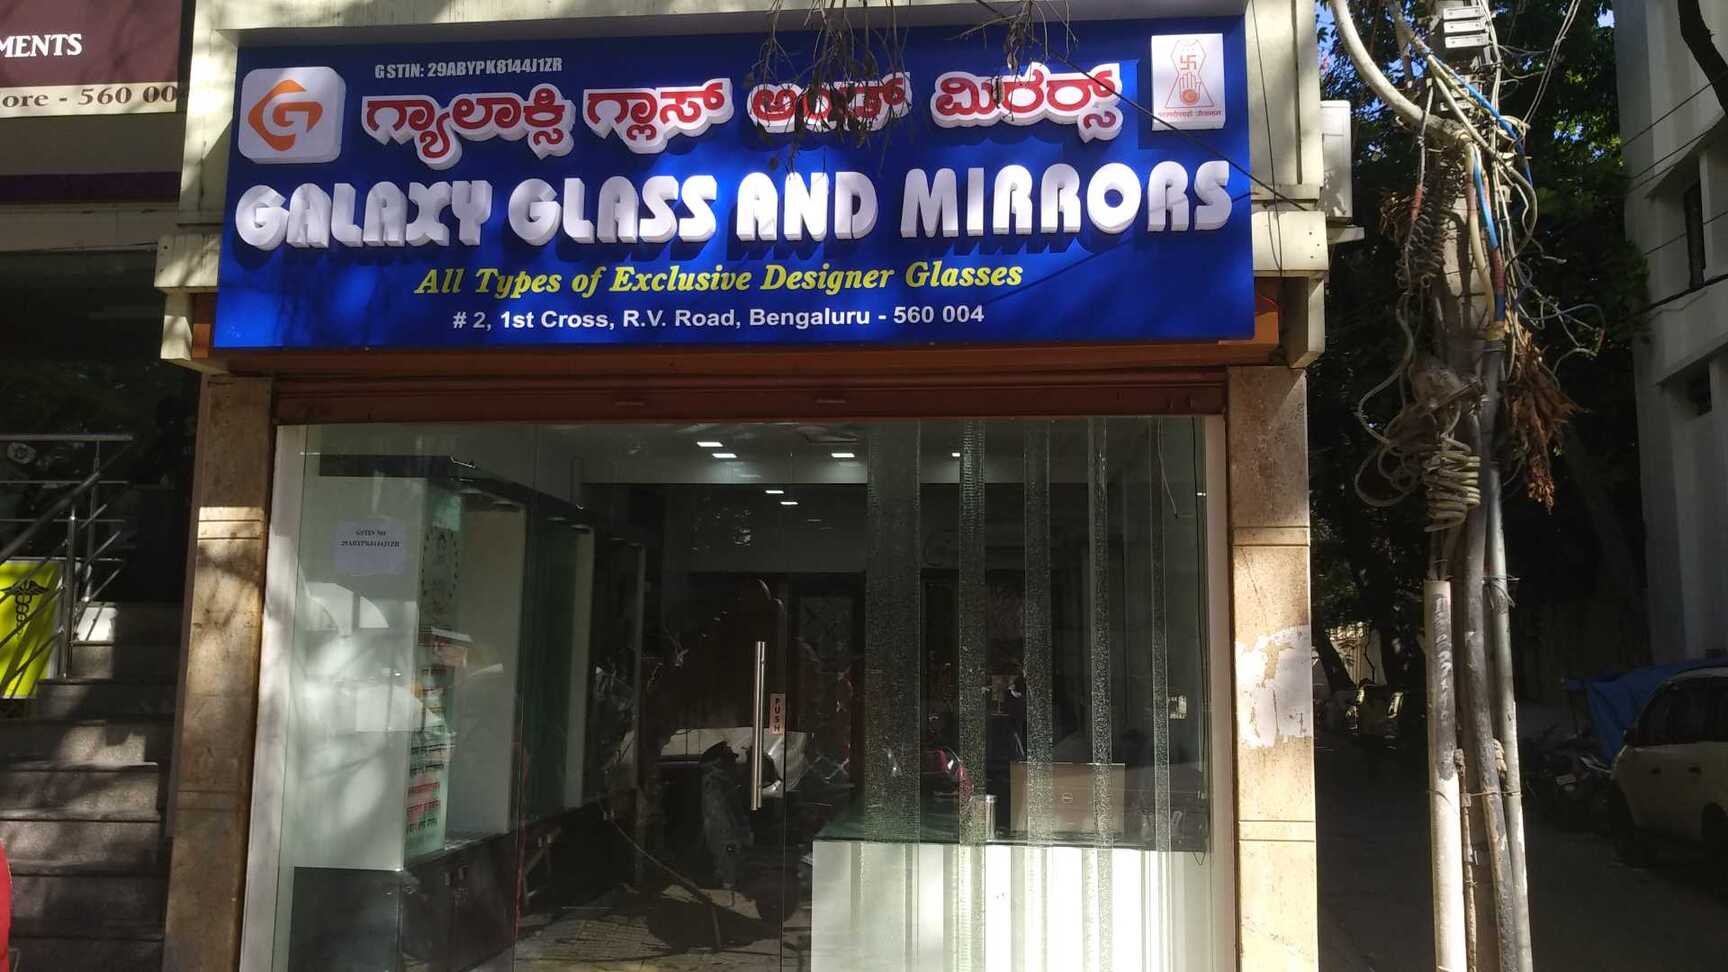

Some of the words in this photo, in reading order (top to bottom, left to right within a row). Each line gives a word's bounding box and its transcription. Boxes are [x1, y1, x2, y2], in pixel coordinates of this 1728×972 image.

[374, 63, 424, 79] GSTIN:
[427, 57, 563, 78] 29ABYPK8144J1ZR
[78, 87, 132, 105] 560
[583, 78, 734, 154] ಗ್ಲಾಸ್
[235, 180, 492, 251] GALAXY
[508, 175, 717, 247] GLASS
[736, 171, 879, 241] AND
[900, 160, 1233, 238] MIRRORS
[414, 268, 464, 294] All
[475, 267, 563, 299] Types
[571, 265, 607, 298] of
[608, 264, 752, 293] Exclusive
[759, 263, 896, 295] Designer
[905, 260, 1024, 288] Glasses
[500, 311, 534, 328] 1st
[541, 310, 615, 331] Cross,
[623, 310, 666, 328] R.V.
[675, 309, 741, 329] Road,
[749, 307, 871, 329] Bengaluru
[893, 306, 935, 324] 560
[942, 305, 985, 324] 004
